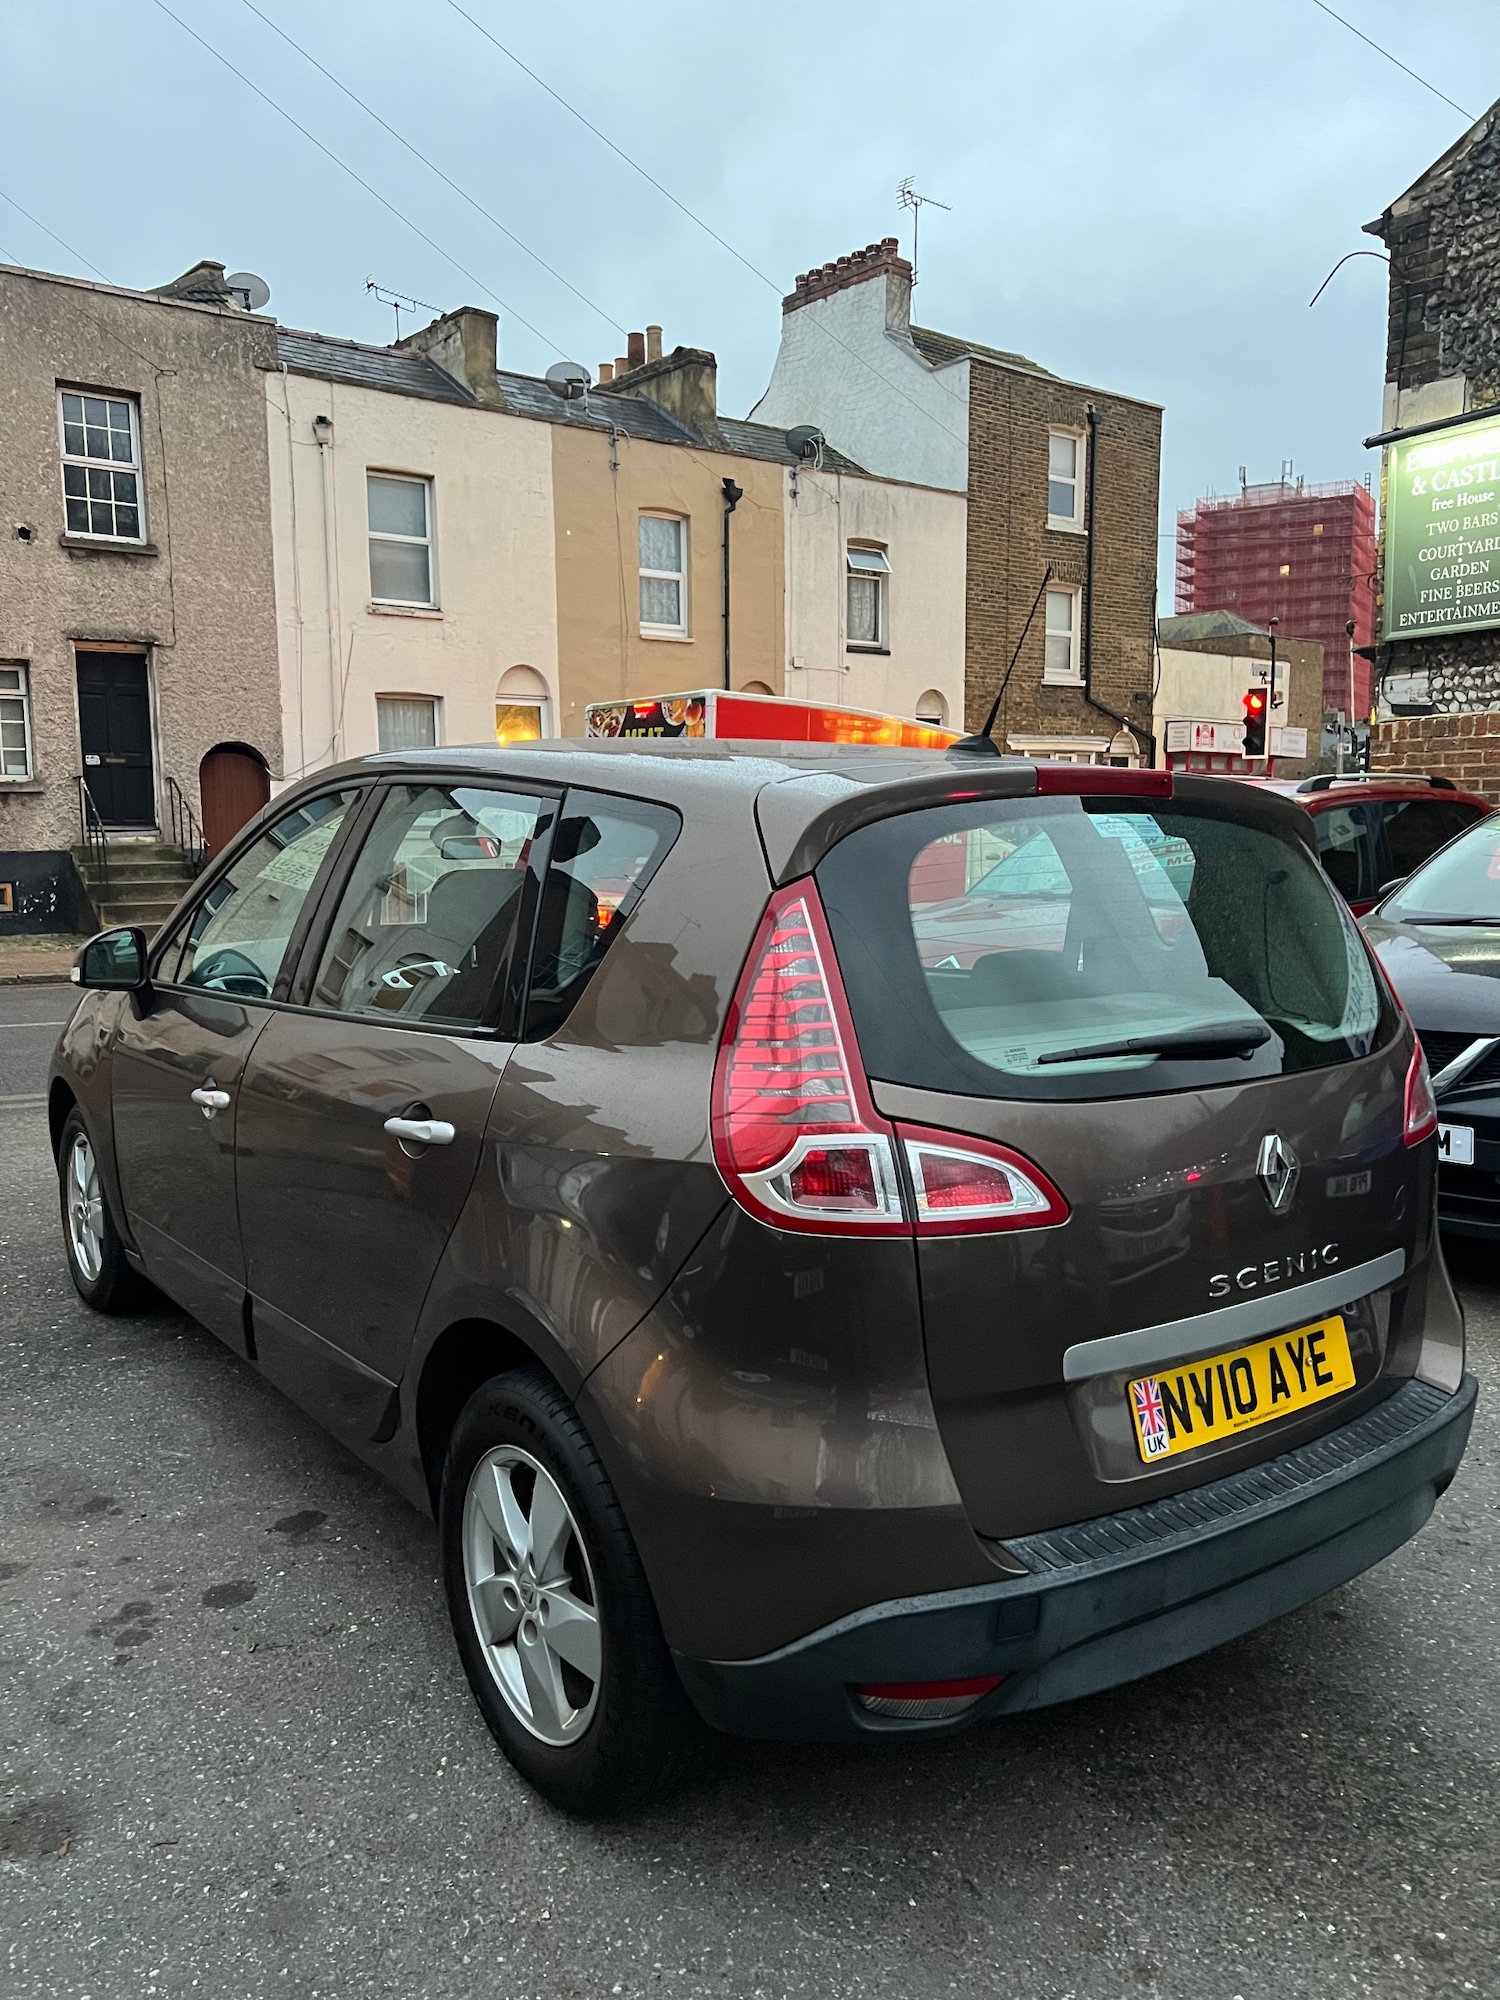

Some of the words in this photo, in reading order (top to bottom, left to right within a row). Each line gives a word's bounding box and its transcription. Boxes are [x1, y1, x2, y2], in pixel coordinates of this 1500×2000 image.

[1411, 475, 1427, 496] &
[1431, 459, 1500, 492] CASTL
[1456, 491, 1495, 507] House
[1425, 519, 1459, 536] TWO
[1462, 512, 1498, 530] BARS
[1430, 560, 1490, 580] GARDEN
[1420, 587, 1452, 603] FINE
[1455, 580, 1500, 598] BEERS
[1399, 601, 1500, 626] ENTERTAINME
[1209, 1243, 1339, 1298] SCENIC
[1160, 1357, 1257, 1440] NV10
[1269, 1329, 1334, 1404] AYE
[1147, 1437, 1167, 1453] UK
